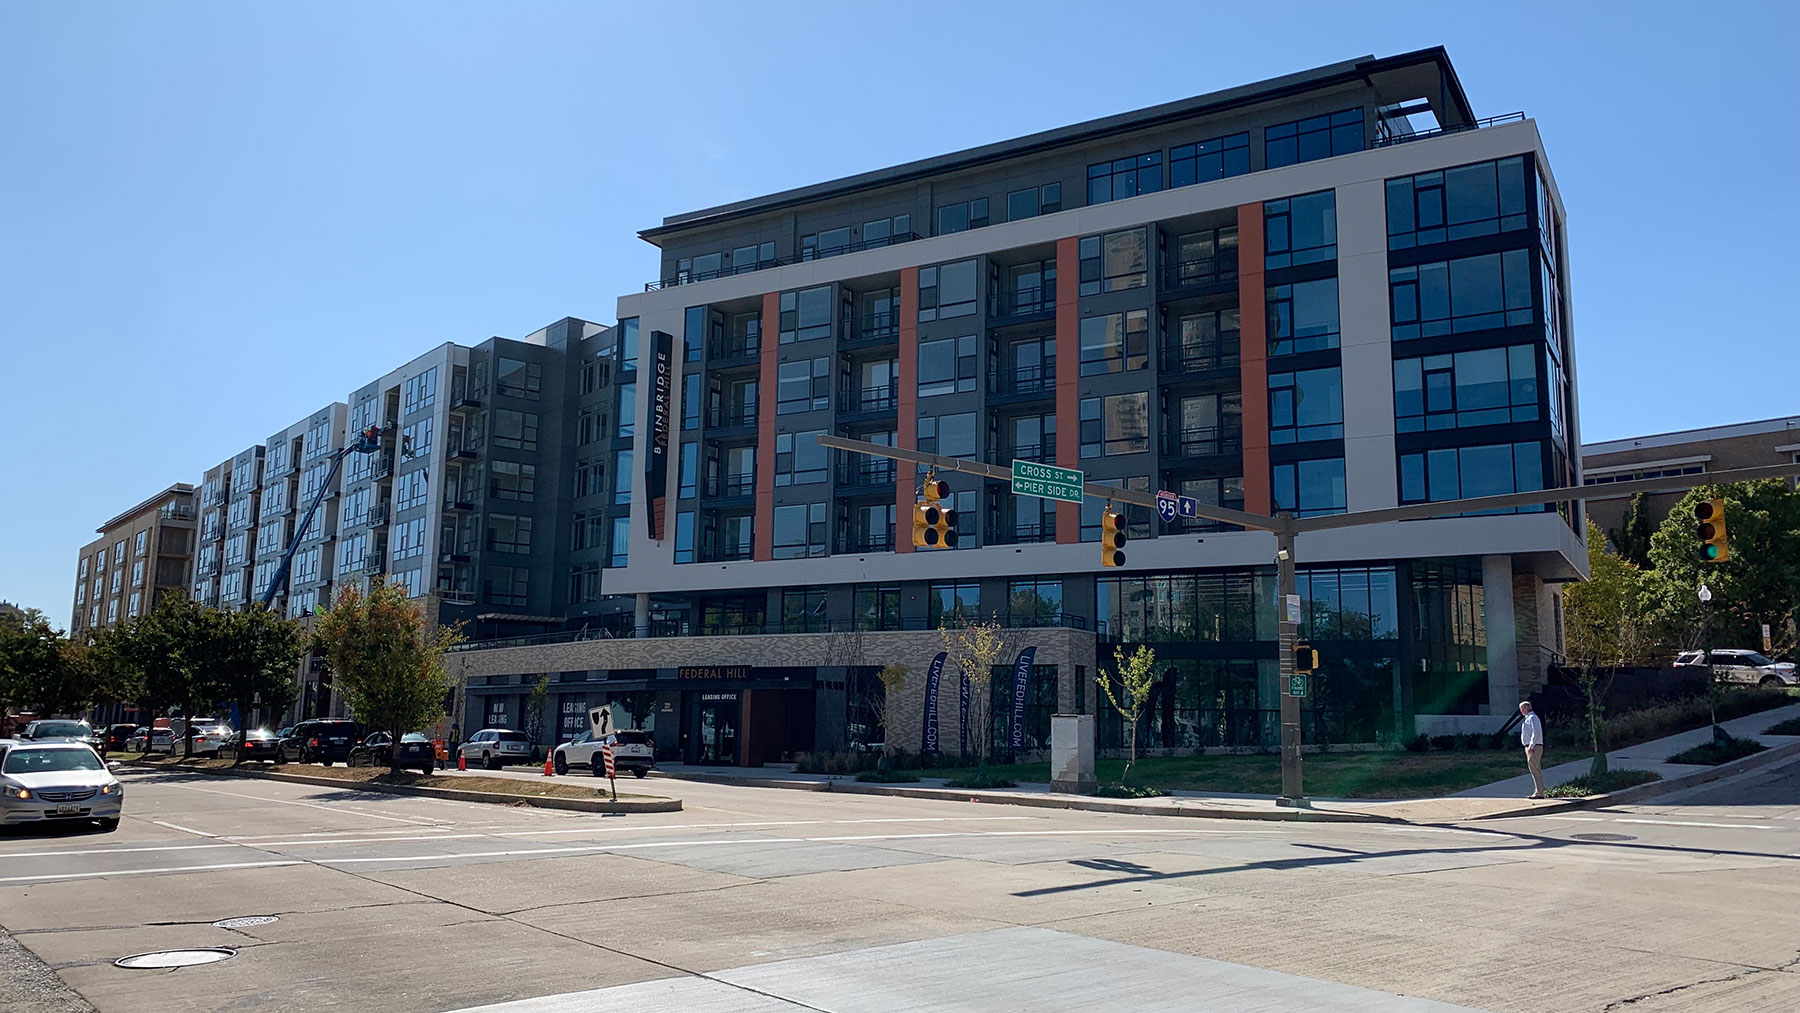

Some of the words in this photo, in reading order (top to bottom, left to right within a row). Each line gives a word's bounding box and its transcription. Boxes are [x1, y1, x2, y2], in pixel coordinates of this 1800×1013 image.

[663, 365, 671, 389] HILL
[654, 352, 666, 454] BAINBRIDGE
[660, 395, 670, 447] FEDERAL
[1020, 465, 1052, 479] CROSS
[1023, 482, 1044, 494] PIER
[1047, 485, 1067, 497] SIDE
[1159, 499, 1175, 516] 95
[679, 668, 722, 679] FEDERAL
[726, 668, 747, 678] HILL
[701, 693, 720, 701] LEASING
[1012, 655, 1031, 748] LIVEFEDHILL.COM
[563, 716, 584, 728] OFFICE
